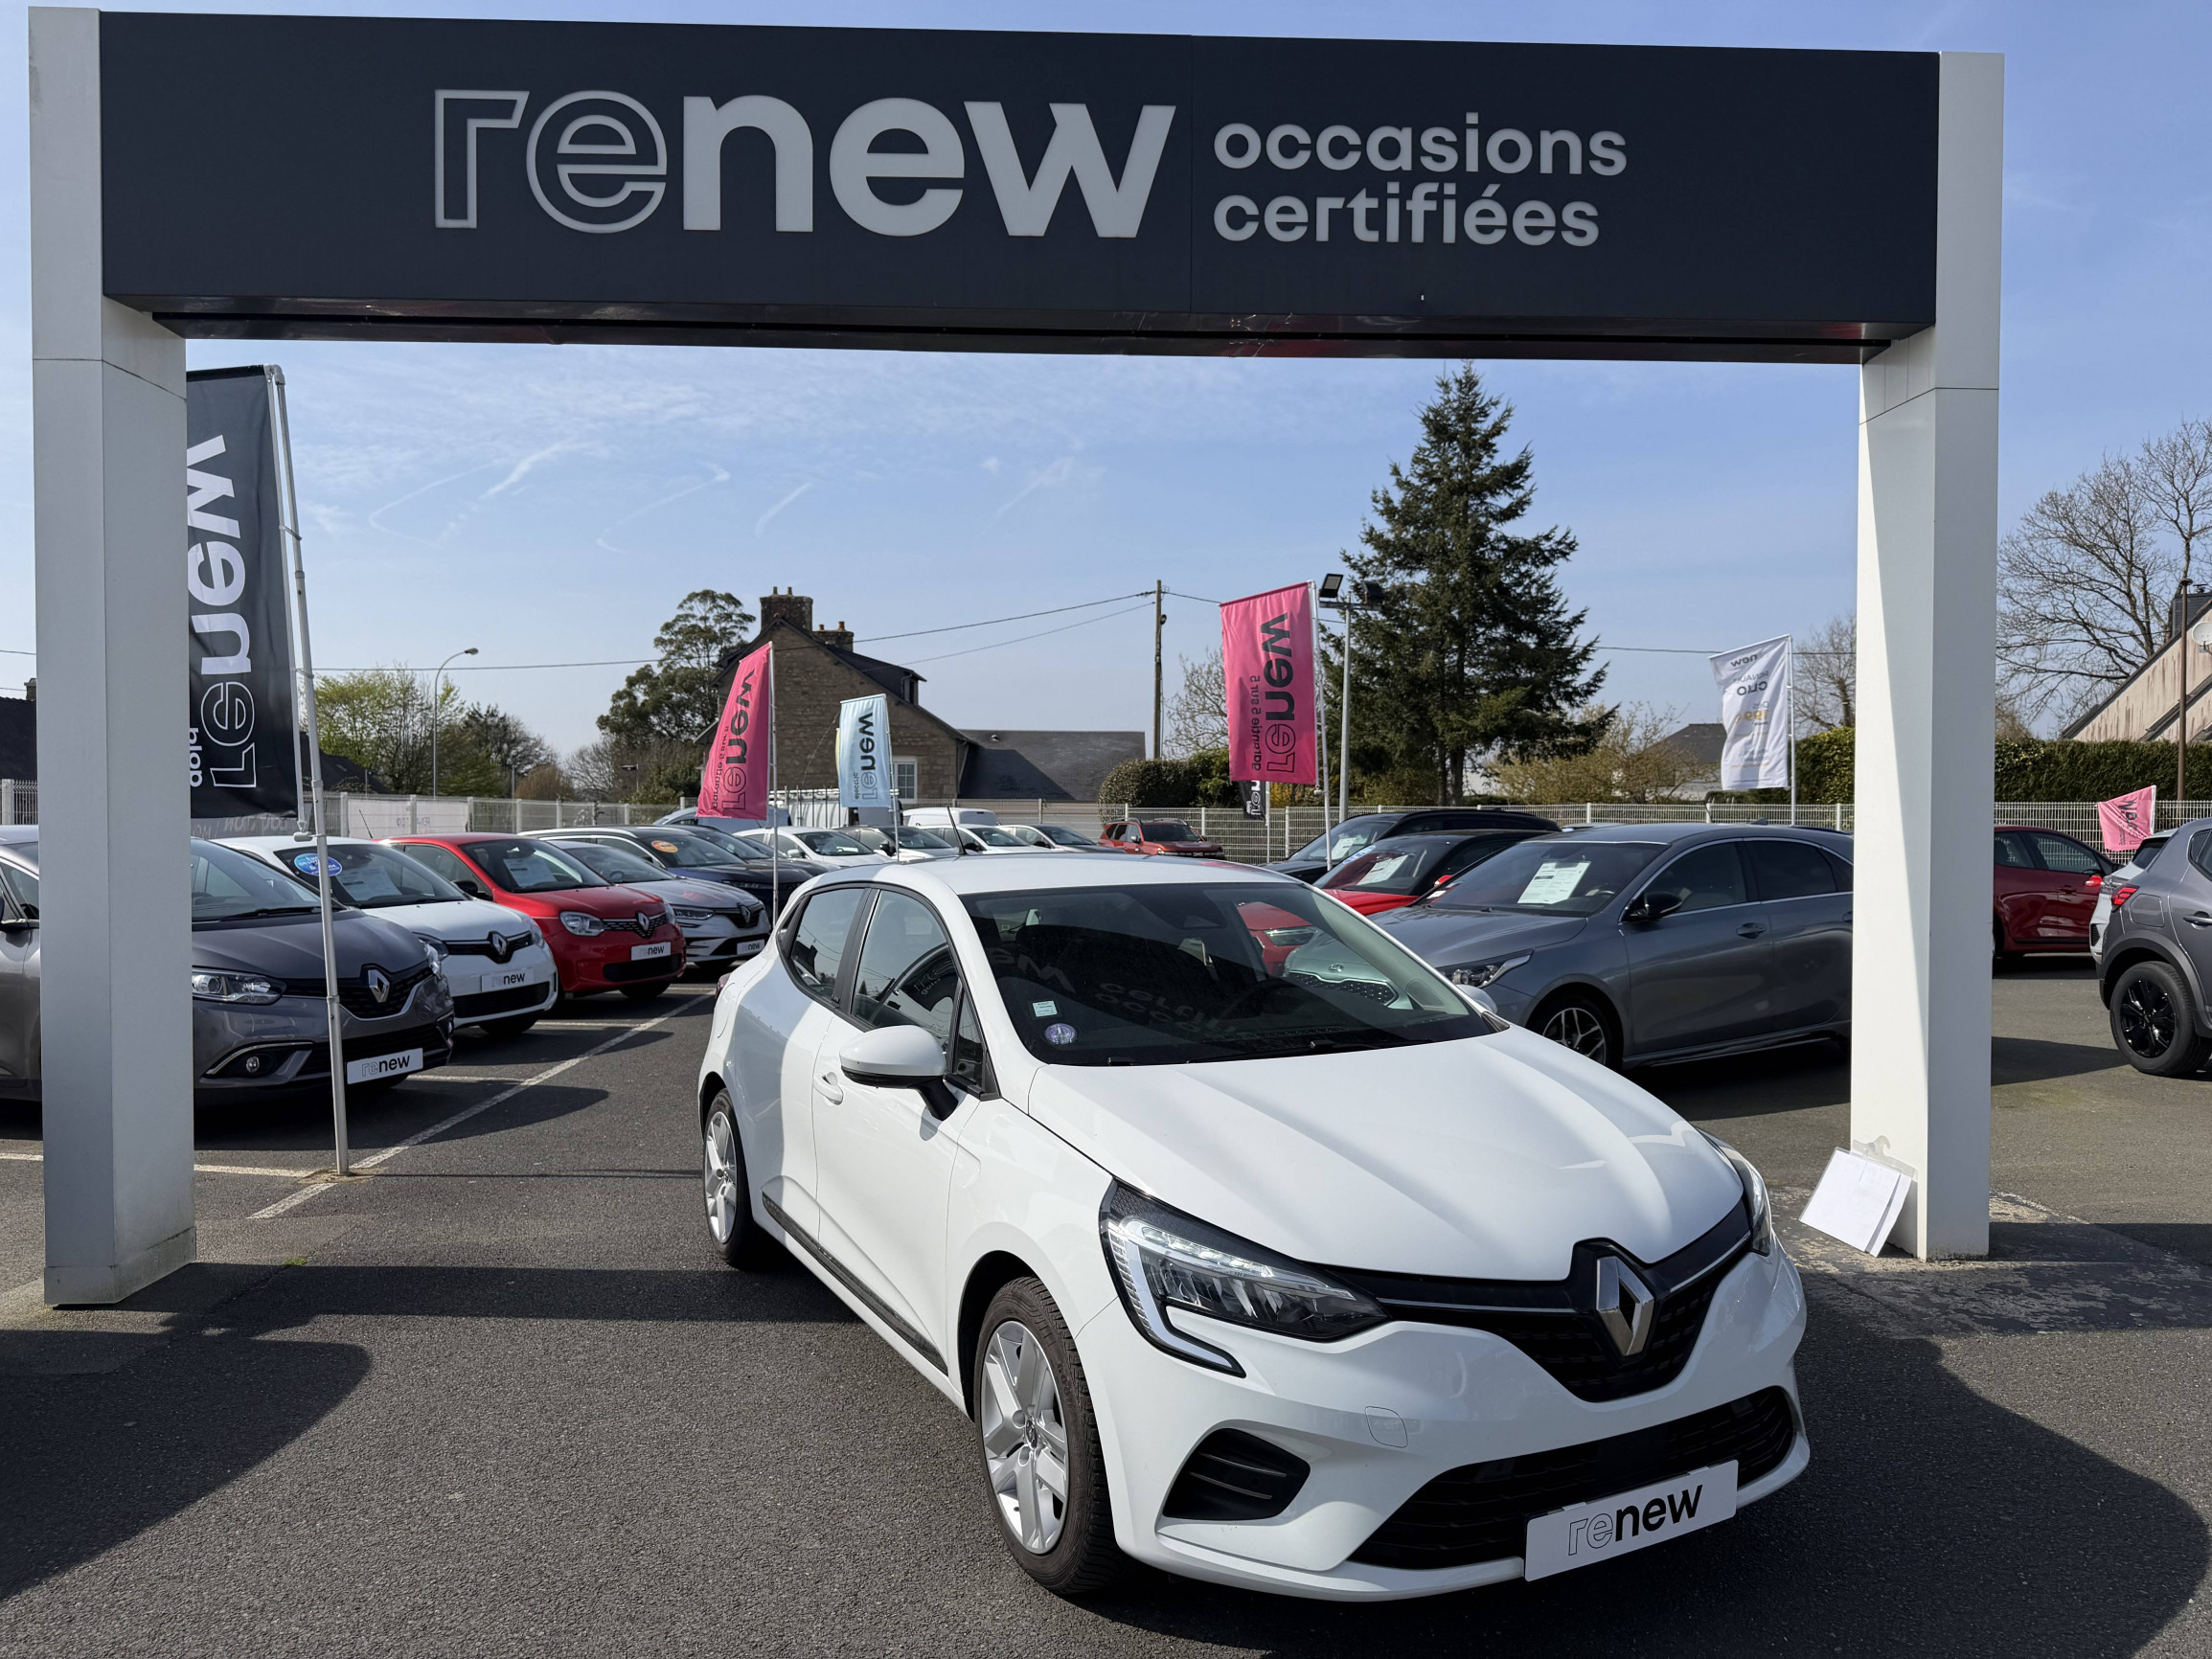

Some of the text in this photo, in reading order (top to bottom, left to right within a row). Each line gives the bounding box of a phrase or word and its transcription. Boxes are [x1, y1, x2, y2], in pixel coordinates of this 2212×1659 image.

[434, 89, 1177, 238] renew
[1213, 111, 1628, 176] occasions
[1213, 181, 1600, 247] certifiées
[361, 1056, 411, 1077] renew
[1568, 1485, 1703, 1557] renew
